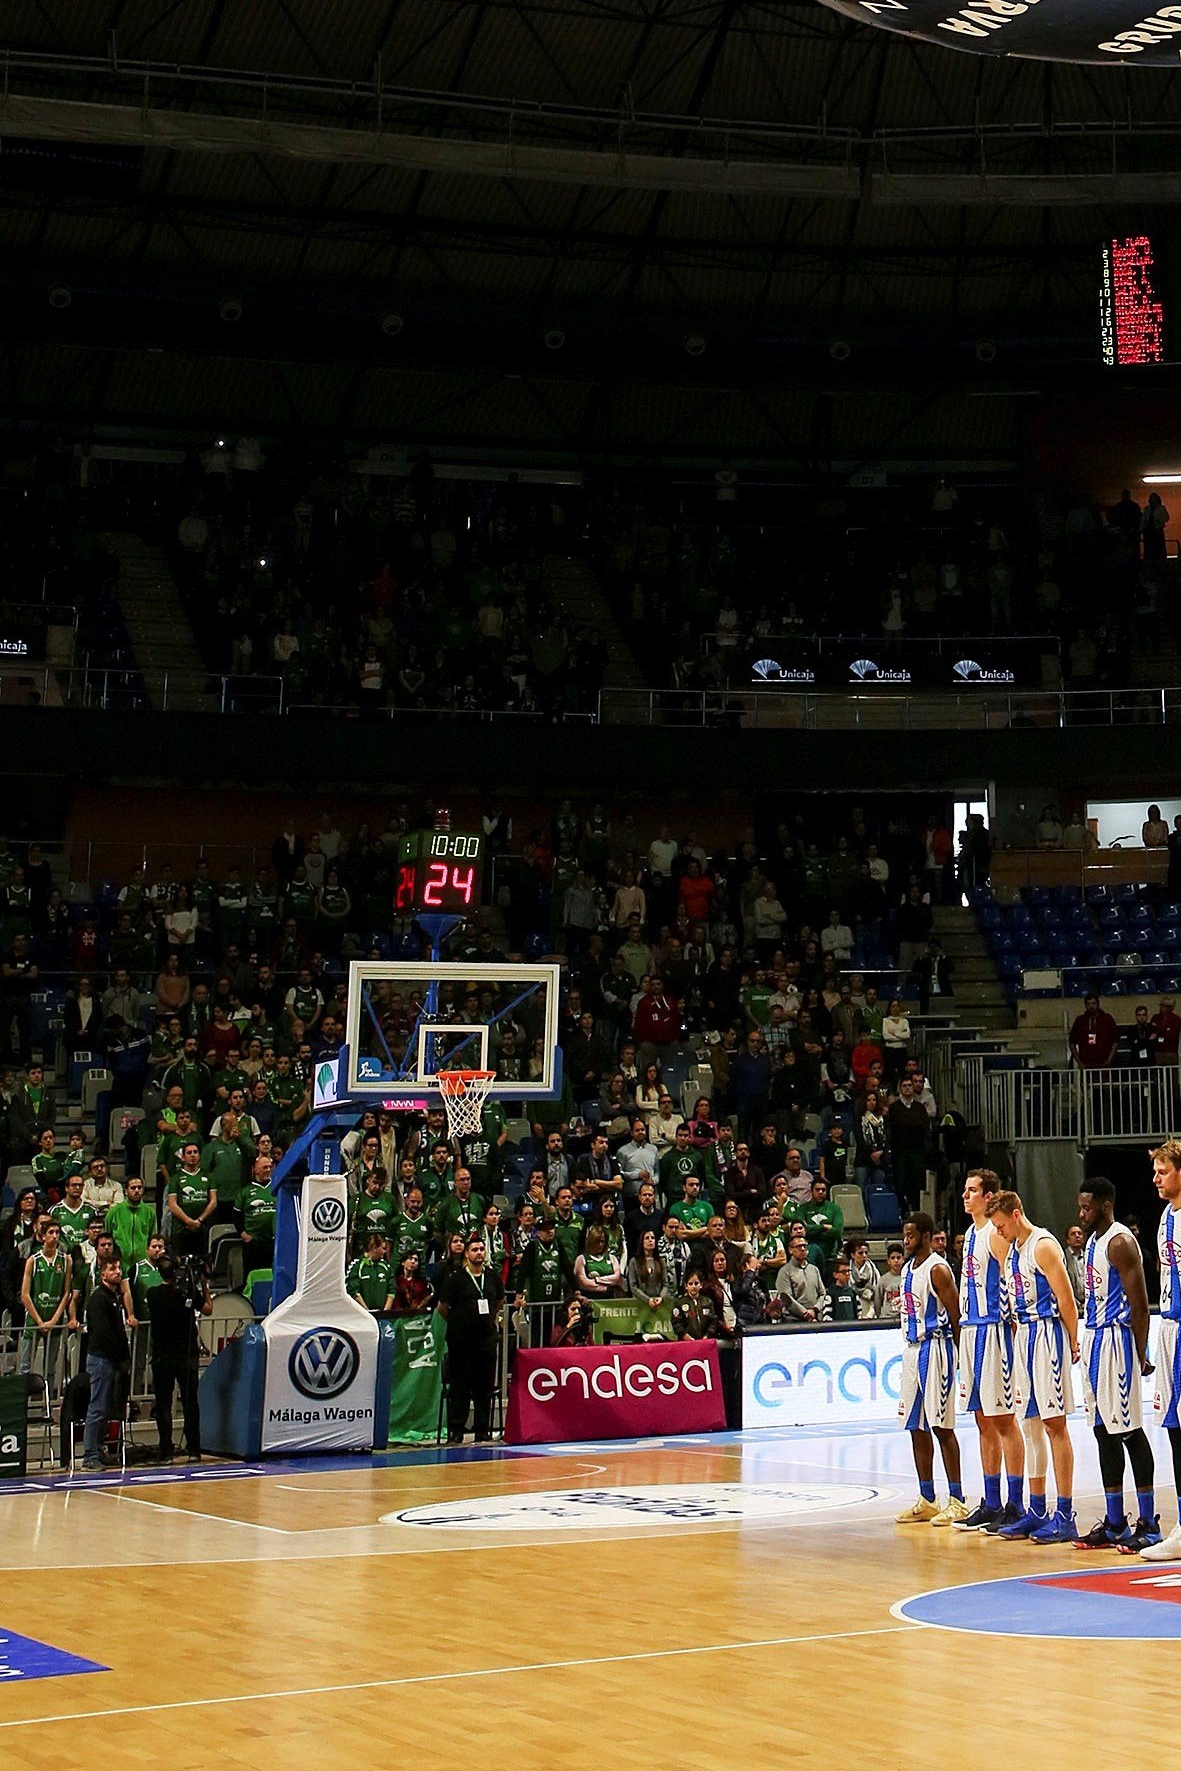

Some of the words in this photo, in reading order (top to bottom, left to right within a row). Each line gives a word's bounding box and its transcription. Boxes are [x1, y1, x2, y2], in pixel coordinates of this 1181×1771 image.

[0, 638, 28, 653] nicaja
[779, 669, 816, 680] Unicaja
[876, 669, 912, 681] Unicaja
[980, 669, 1015, 681] Unicaja
[430, 835, 480, 858] 10:00
[423, 864, 474, 905] 24
[599, 1306, 639, 1319] FRENTE
[527, 1354, 713, 1403] endesa
[269, 1407, 321, 1425] Málaga
[323, 1407, 373, 1424] Wagen
